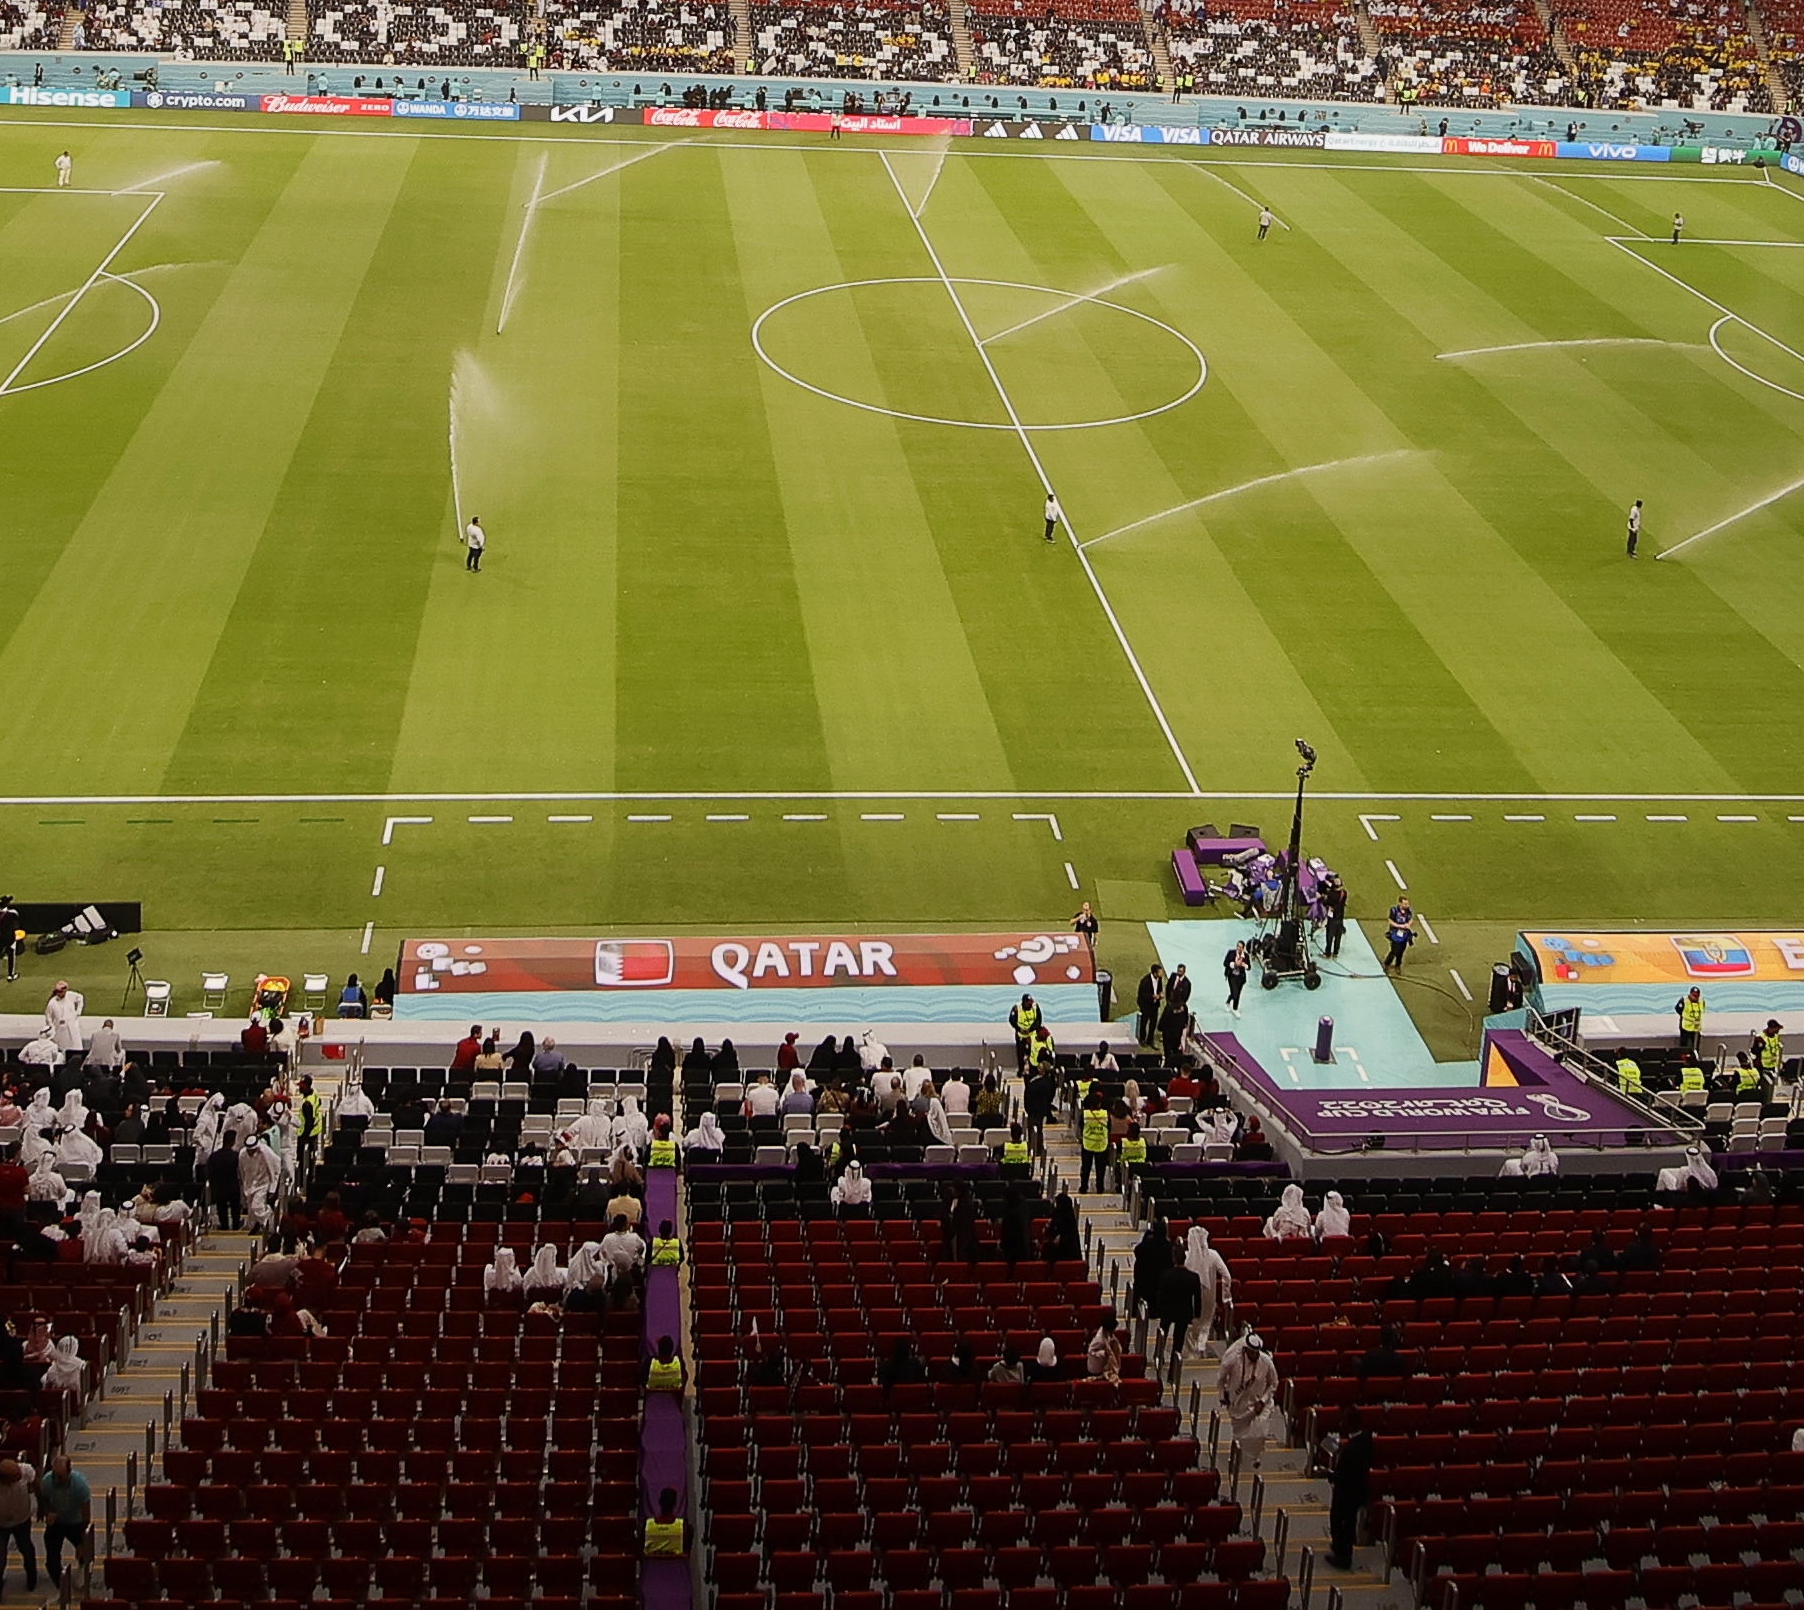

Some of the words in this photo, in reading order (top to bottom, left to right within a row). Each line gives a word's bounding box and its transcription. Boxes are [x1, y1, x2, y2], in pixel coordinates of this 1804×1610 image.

[9, 89, 115, 107] Hisense
[166, 90, 245, 109] crypto.com
[263, 96, 351, 113] Budweiser
[360, 103, 390, 112] ZERO
[410, 105, 447, 115] WANDA
[651, 110, 700, 127] Coca-Cola
[713, 111, 762, 128] Coca-Cola
[1103, 127, 1142, 142] VISA
[1160, 129, 1201, 144] VISA
[1211, 130, 1260, 146] QATAR
[1264, 131, 1324, 147] AIRWAYS
[1328, 136, 1378, 148] QatarEnergy
[1468, 141, 1487, 153] We
[1488, 141, 1530, 155] Deliver
[1589, 143, 1637, 159] vivo
[710, 942, 898, 990] QATAR
[1316, 1109, 1369, 1118] CUP
[1372, 1108, 1468, 1117] WORLD
[1467, 1106, 1531, 1115] FIFA
